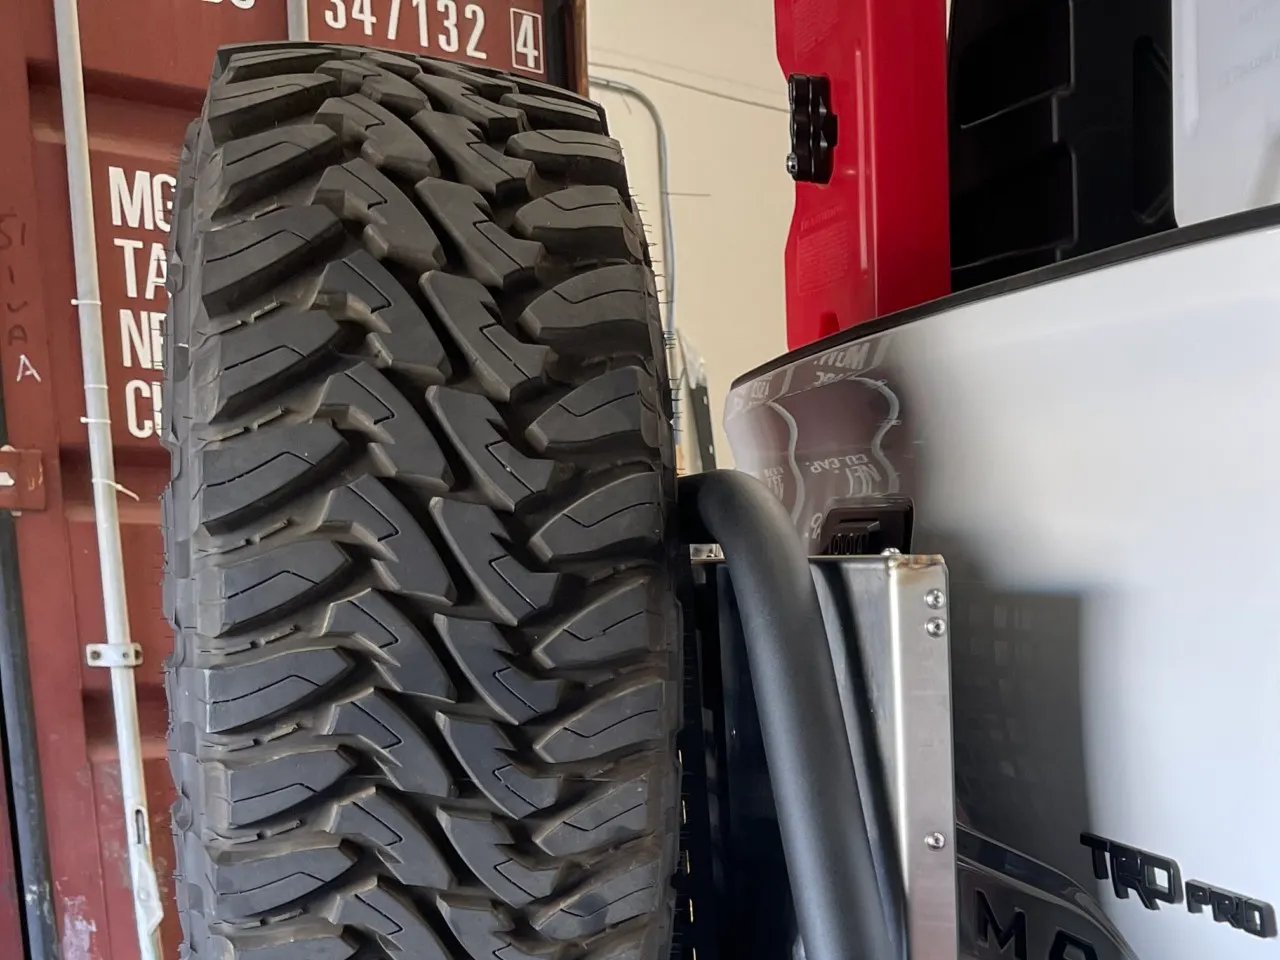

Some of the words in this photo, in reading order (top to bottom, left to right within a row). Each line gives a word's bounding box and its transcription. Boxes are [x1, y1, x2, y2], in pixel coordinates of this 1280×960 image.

[515, 14, 539, 68] 4
[108, 166, 176, 232] MG
[1080, 832, 1184, 910] TRD
[1185, 879, 1278, 938] PRO
